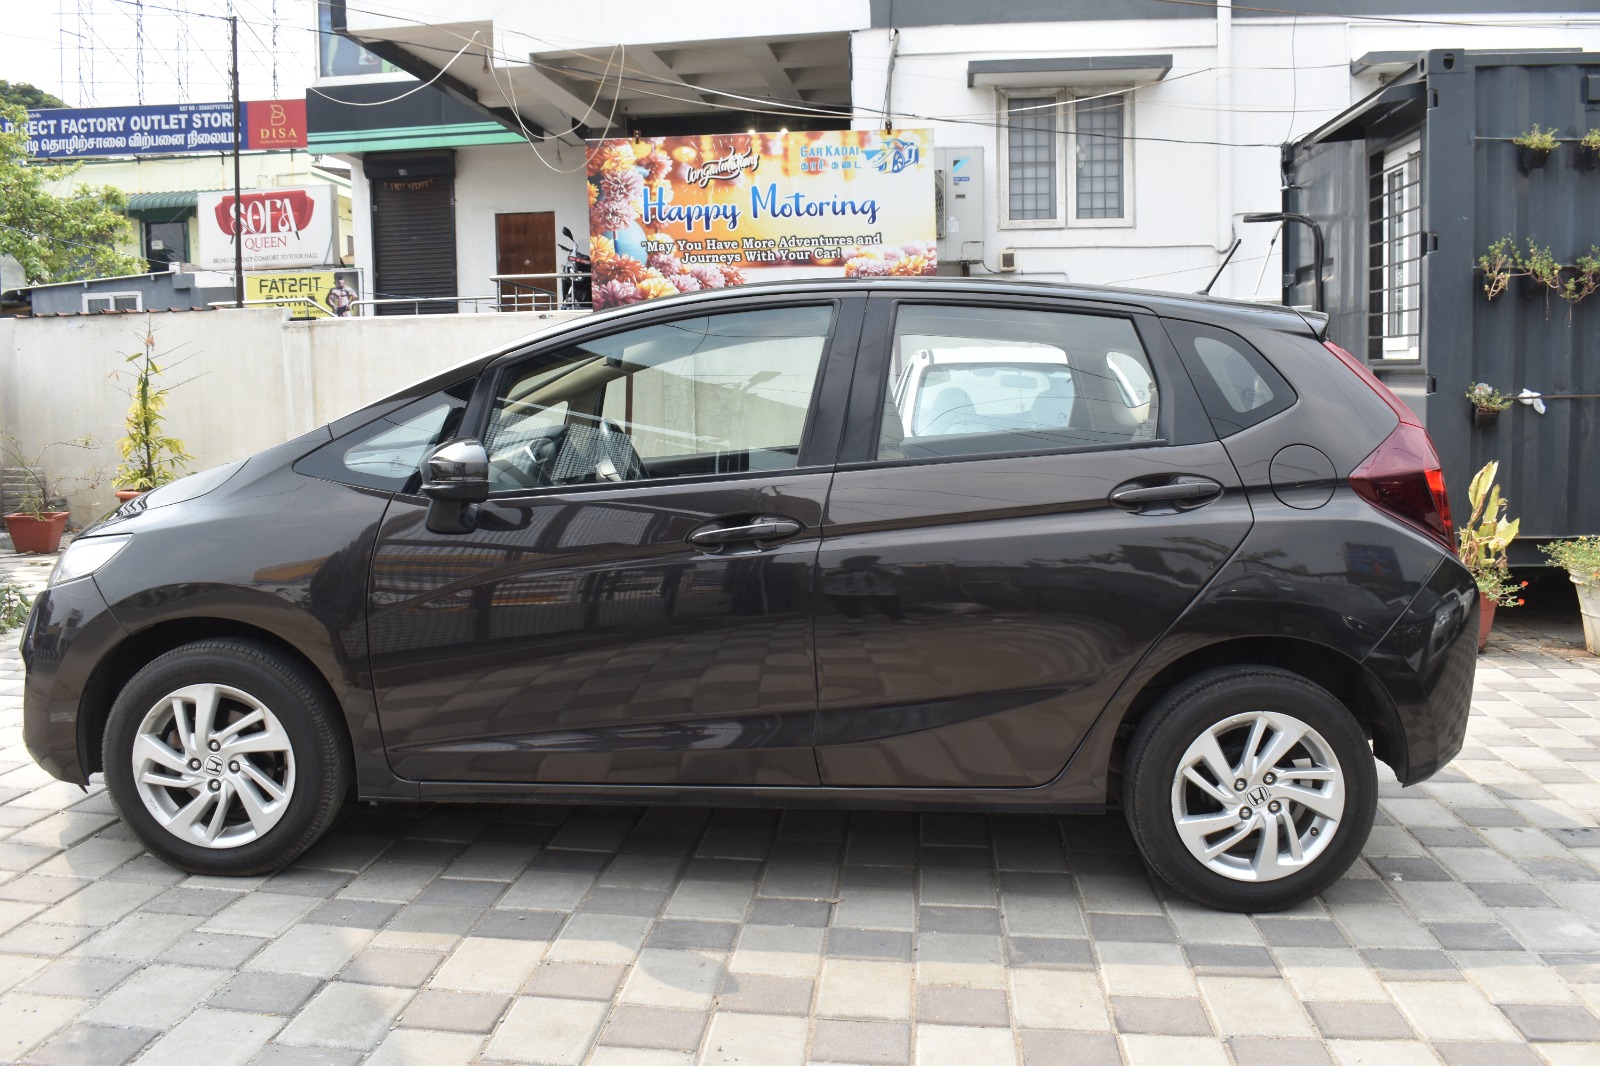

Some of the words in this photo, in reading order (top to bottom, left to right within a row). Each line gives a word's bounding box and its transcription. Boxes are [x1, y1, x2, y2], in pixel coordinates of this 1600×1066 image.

[61, 116, 126, 134] FACTORY
[130, 113, 188, 131] OUTLET
[260, 127, 298, 139] DISA
[41, 135, 127, 155] தொழிற்சாலை
[128, 131, 185, 151] விற்பனை
[642, 186, 741, 231] Happy
[751, 183, 881, 225] Motoring
[229, 198, 298, 235] SOFA
[244, 235, 287, 252] QUEEN
[676, 239, 703, 251] You
[706, 239, 739, 251] Have
[742, 237, 775, 249] More
[778, 234, 854, 248] Adventures
[857, 232, 882, 245] and
[253, 253, 280, 263] COMFORT
[681, 251, 742, 265] Journeys
[744, 250, 776, 262] With
[779, 249, 811, 261] Your
[814, 247, 842, 260] Car!
[259, 276, 322, 294] FAT2FIT
